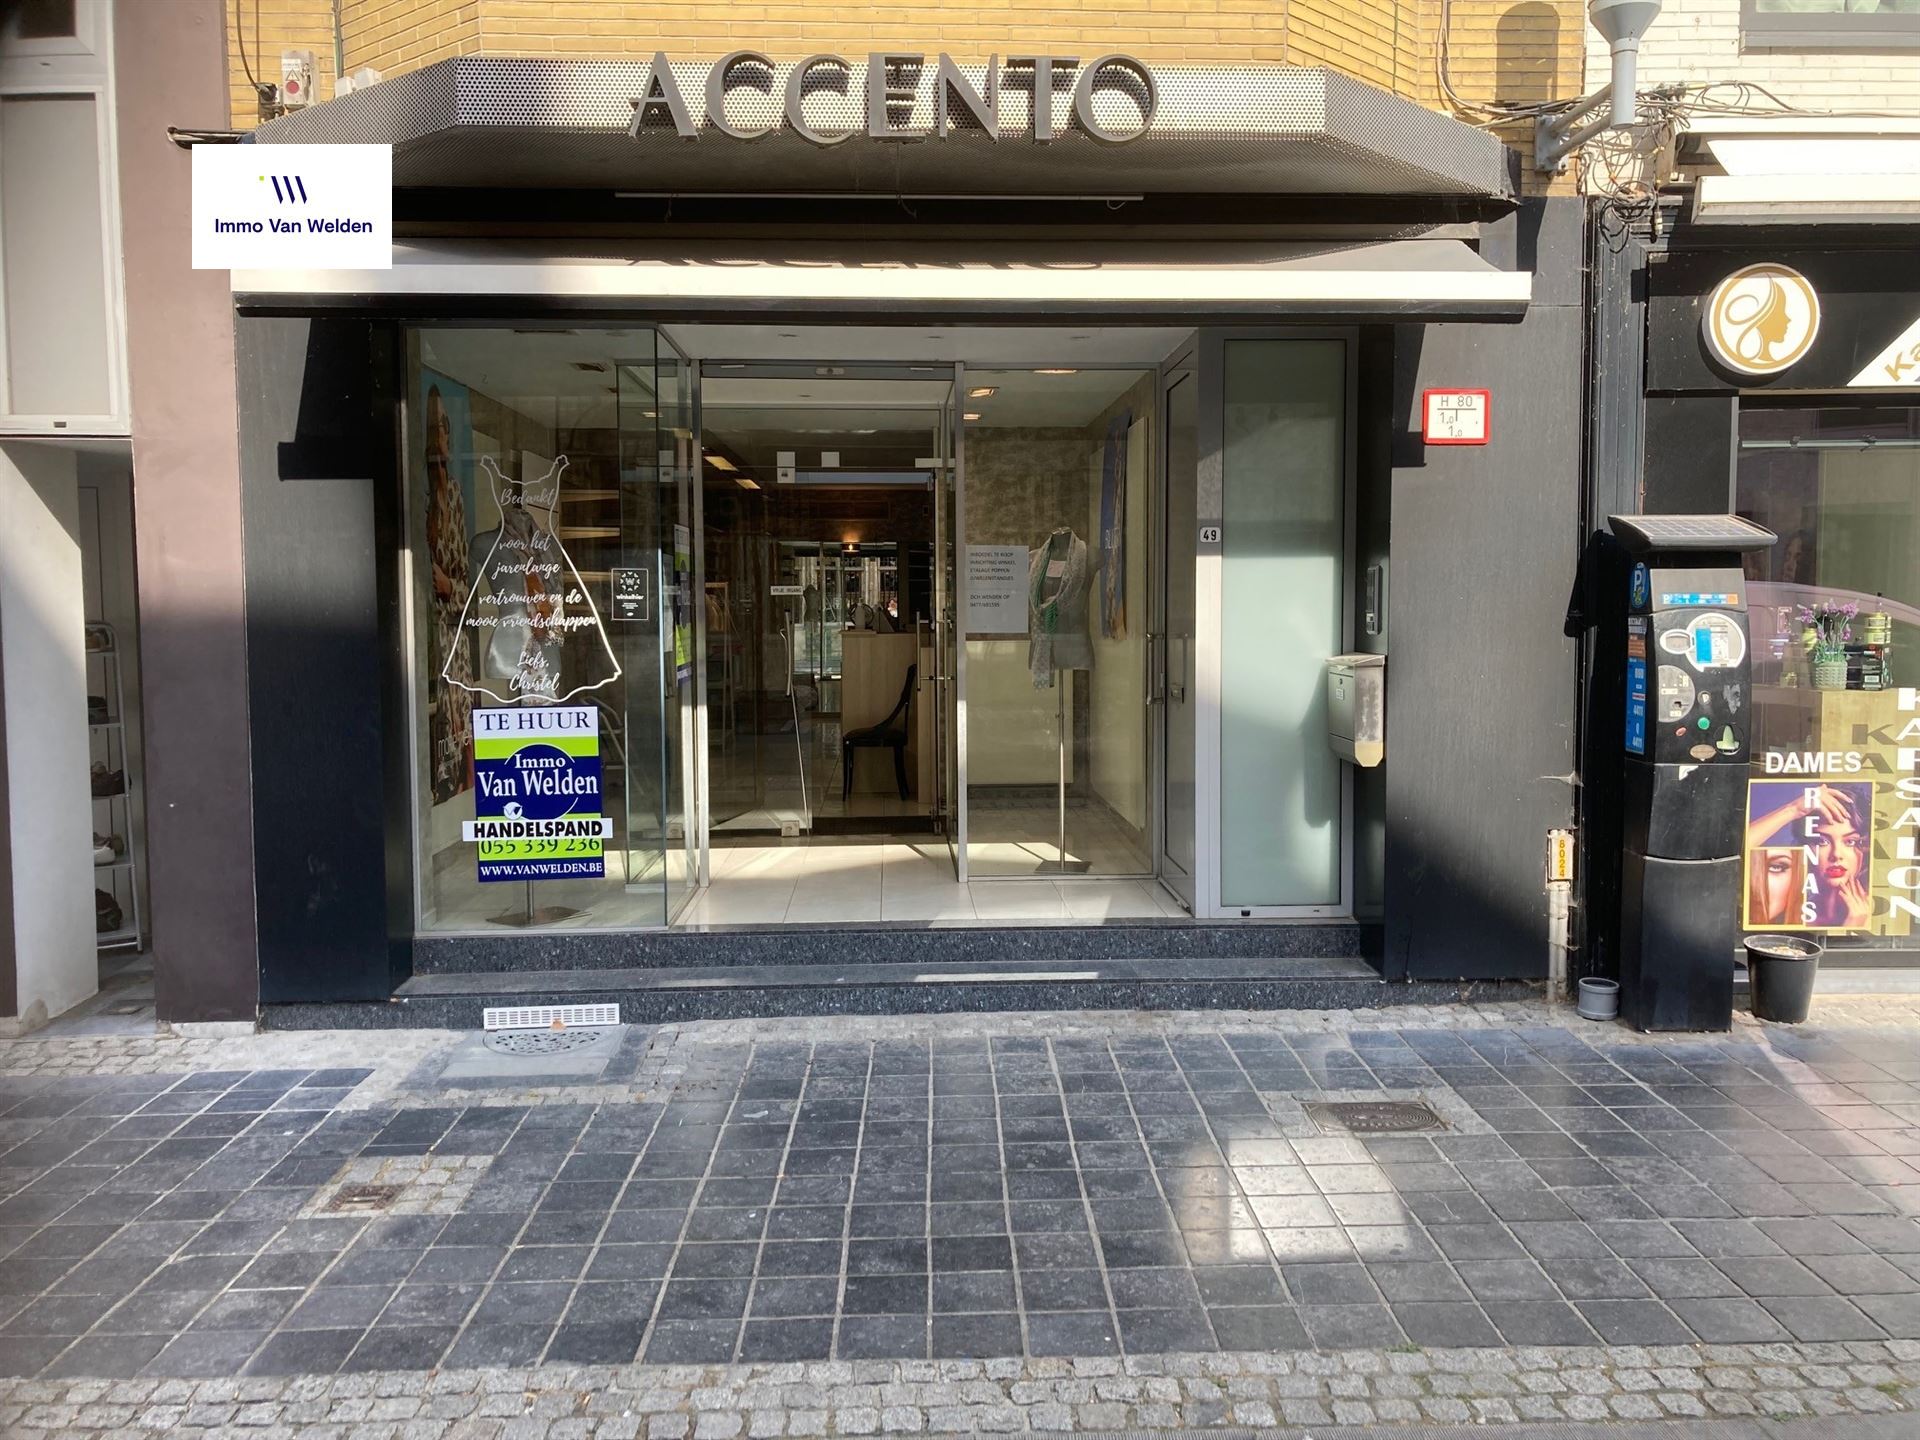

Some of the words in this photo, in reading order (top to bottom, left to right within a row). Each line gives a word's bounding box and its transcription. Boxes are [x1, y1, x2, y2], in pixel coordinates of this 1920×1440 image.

[629, 50, 1160, 147] ACCENTO
[1440, 396, 1448, 407] H
[1458, 396, 1472, 407] 80
[501, 488, 555, 506] Bedankt
[499, 540, 527, 550] voor
[531, 532, 551, 551] het
[1204, 530, 1216, 540] 49
[492, 556, 560, 580] jarenlange
[478, 589, 546, 606] vertrouwen
[550, 594, 563, 604] en
[565, 588, 582, 604] de
[466, 616, 498, 627] mooie
[502, 610, 598, 632] vriendschappen
[509, 672, 560, 692] Christel
[480, 713, 510, 730] TE
[517, 712, 590, 730] HUUR
[514, 754, 566, 769] Immo
[1765, 751, 1861, 773] DAMES
[477, 771, 517, 797] Van
[521, 769, 599, 796] Welden
[474, 821, 603, 838] HANDELSPAND
[481, 840, 516, 854] 055
[524, 838, 558, 853] 339
[565, 838, 600, 851] 236
[1801, 787, 1822, 923] RENAS
[480, 862, 603, 876] WWW.VANWELDEN.BE
